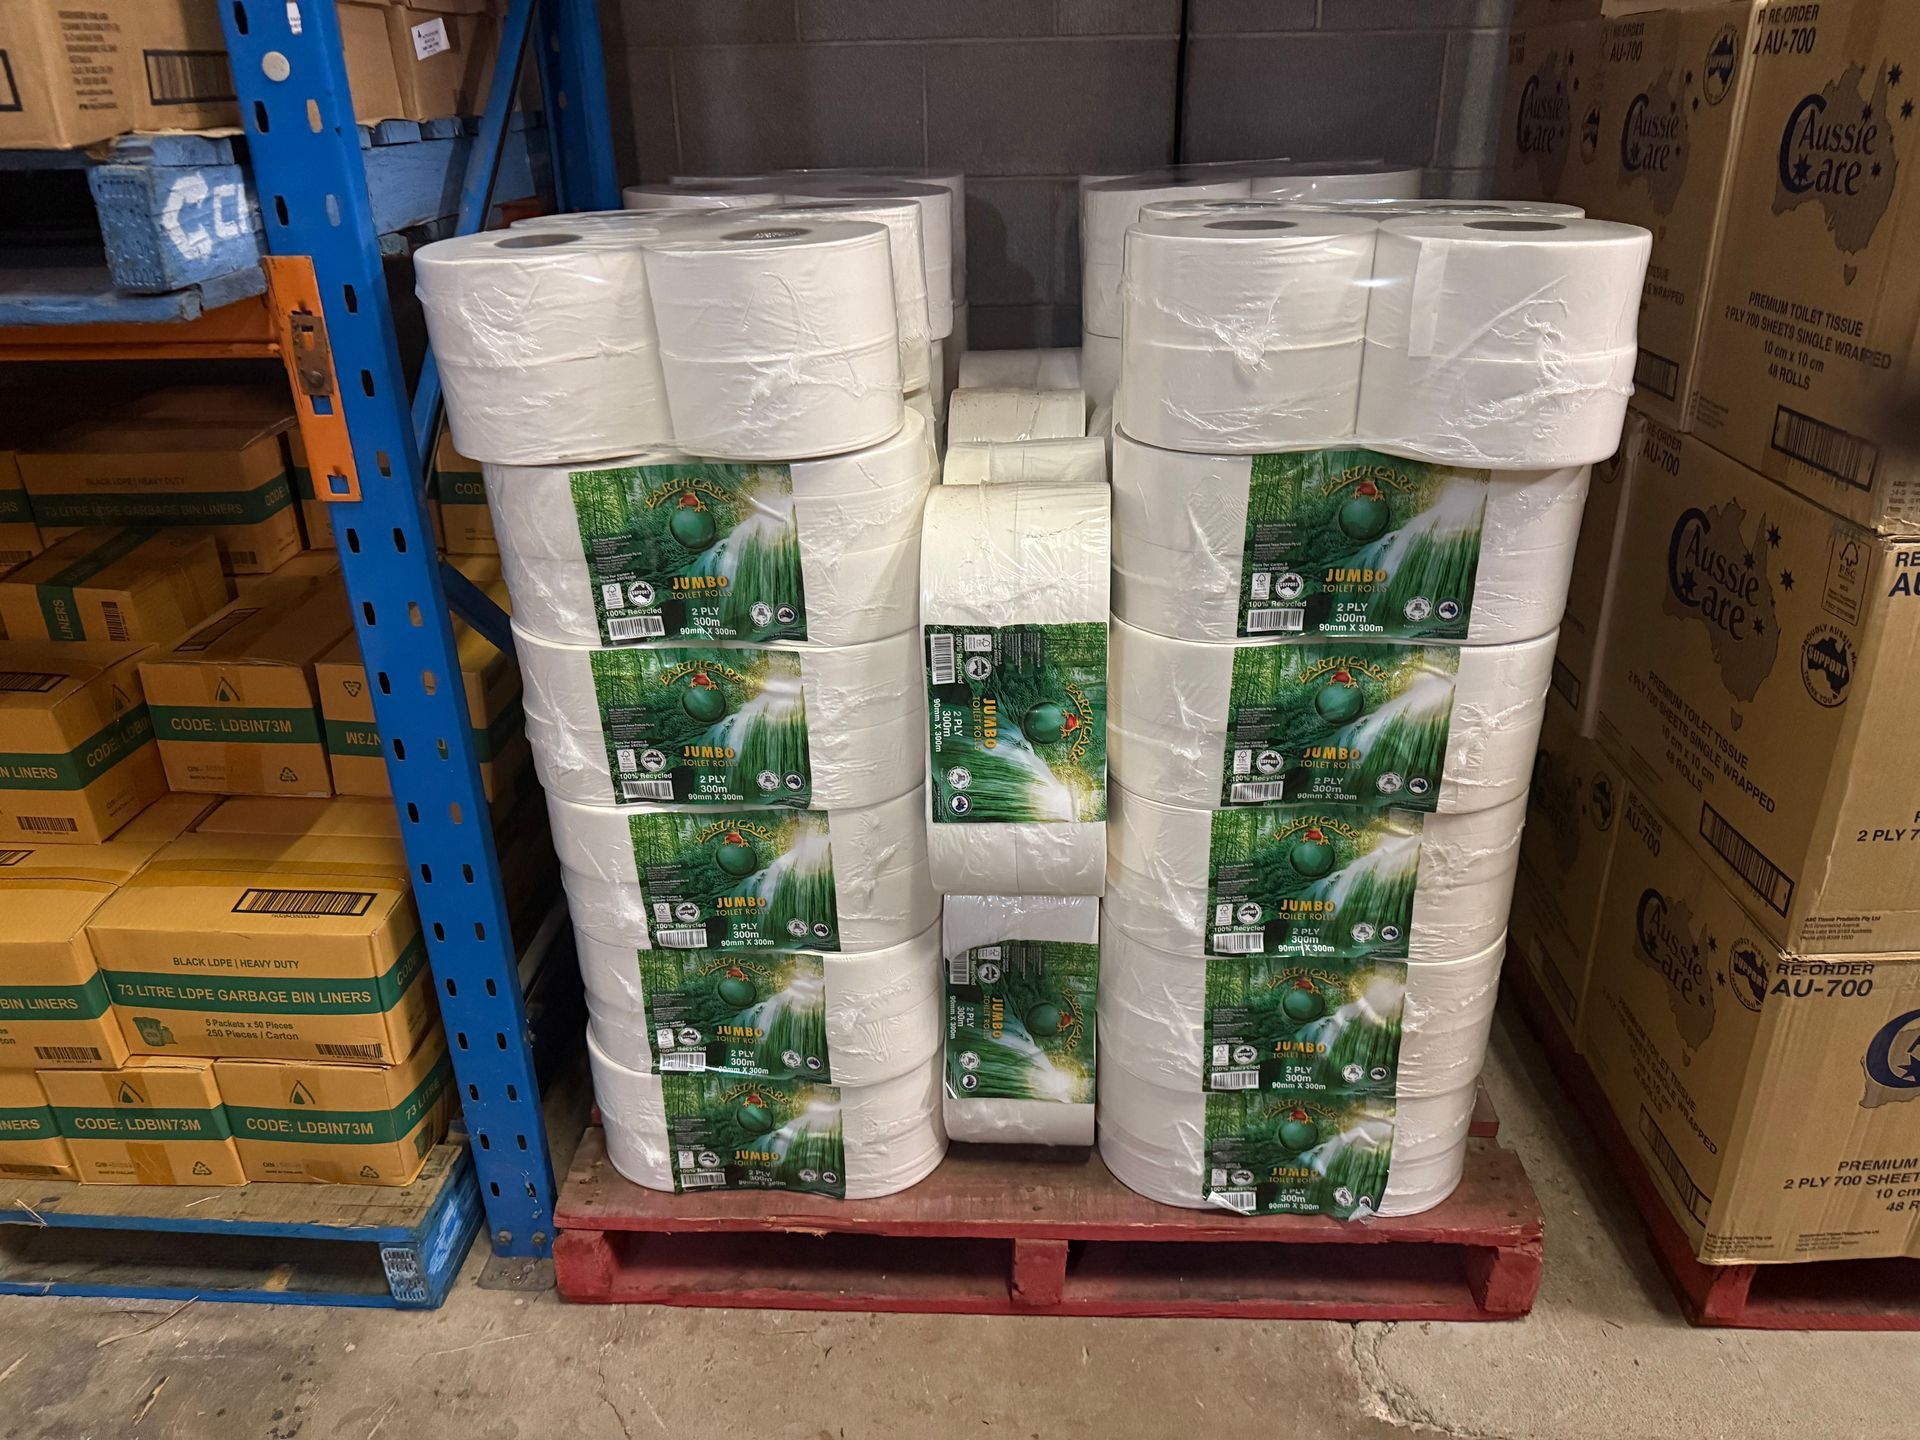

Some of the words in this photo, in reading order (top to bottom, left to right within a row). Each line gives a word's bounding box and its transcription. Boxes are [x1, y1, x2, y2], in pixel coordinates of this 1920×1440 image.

[1768, 4, 1820, 24] RE-ORDER
[1762, 27, 1816, 54] AU-700
[1610, 40, 1642, 63] AU-700
[1633, 104, 1679, 138] Aussie
[1621, 93, 1670, 172] Care
[1798, 109, 1877, 155] Aussie
[1779, 93, 1862, 196] Care
[1748, 292, 1789, 315] PREMIUM
[1790, 303, 1824, 326] TOILET
[1826, 313, 1863, 337] TISSUE
[1729, 306, 1746, 322] PLY
[1746, 312, 1760, 329] 700
[1761, 316, 1795, 339] SHEETS
[1797, 328, 1833, 352] SINGLE
[1763, 340, 1773, 354] 10
[1774, 345, 1787, 359] cm
[1789, 352, 1794, 361] x
[1798, 351, 1808, 366] 10
[1809, 358, 1824, 373] cm
[1779, 368, 1811, 391] ROLLS
[1644, 439, 1680, 477] AU-700
[1321, 465, 1417, 497] EARTHCARE
[1668, 507, 1745, 641] Care
[1685, 524, 1760, 607] Aussie
[672, 576, 729, 590] JUMBO
[1326, 569, 1388, 582] JUMBO
[1322, 584, 1354, 593] TOILET
[1358, 584, 1387, 592] ROLLS
[701, 607, 719, 616] PLY
[1347, 603, 1368, 612] PLY
[52, 600, 74, 641] LINERS
[694, 617, 720, 626] 300m
[1335, 613, 1366, 623] 300m
[1359, 624, 1383, 632] 300m
[1801, 624, 1828, 650] PROUDLY
[1299, 656, 1390, 684] EARTHCARE
[1807, 645, 1847, 679] SUPPORT
[659, 660, 744, 686] EARTHCARE
[1819, 693, 1833, 704] YOU
[171, 718, 217, 731] CODE:
[221, 719, 292, 733] LDBIN73M
[943, 711, 951, 737] 300m
[983, 698, 998, 748] JUMBO
[1648, 671, 1683, 711] PREMIUM
[1684, 704, 1713, 738] TOILET
[1714, 731, 1749, 770] TISSUE
[1628, 670, 1633, 682] 2
[1633, 674, 1647, 696] PLY
[1659, 702, 1688, 737] SHEETS
[1690, 730, 1721, 769] SINGLE
[1723, 762, 1775, 813] WRAPPED
[683, 746, 735, 759] JUMBO
[1303, 747, 1361, 760] JUMBO
[1662, 724, 1670, 739] 10
[1670, 735, 1683, 753] cm
[1691, 753, 1700, 770] 10
[1702, 767, 1715, 784] cm
[709, 775, 726, 783] PLY
[1676, 758, 1703, 793] ROLLS
[701, 785, 727, 793] 300m
[1313, 785, 1342, 793] 300m
[695, 819, 776, 844] EARTHCARE
[1273, 816, 1360, 841] EARTHCARE
[1624, 807, 1661, 858] AU-700
[1857, 830, 1868, 842] 2
[1872, 829, 1906, 841] PLY
[717, 897, 767, 908] JUMBO
[1281, 899, 1335, 912] JUMBO
[1292, 936, 1319, 944] 300m
[1636, 888, 1692, 1005] Care
[1651, 904, 1703, 986] Aussie
[173, 957, 206, 967] BLACK
[208, 957, 233, 967] LDPE
[240, 958, 271, 968] HEAVY
[274, 959, 299, 969] DUTY
[1776, 964, 1875, 976] RE-ORDER
[117, 984, 134, 996] 73
[136, 986, 175, 998] LITRE
[178, 988, 214, 1001] LDPE
[217, 989, 288, 1003] GARBAGE
[292, 991, 315, 1004] BIN
[319, 991, 372, 1004] LINERS
[1770, 979, 1873, 998] AU-700
[27, 998, 78, 1010] LINERS
[205, 1018, 211, 1026] 5
[212, 1019, 245, 1029] Packets
[254, 1021, 263, 1029] 50
[265, 1021, 293, 1030] Pieces
[957, 1007, 965, 1027] 300m
[992, 998, 1004, 1039] JUMBO
[206, 1029, 224, 1038] 250
[226, 1029, 259, 1039] Pieces
[266, 1031, 299, 1041] Carton
[717, 1026, 764, 1037] JUMBO
[1274, 1041, 1327, 1054] JUMBO
[731, 1058, 755, 1067] 300m
[1285, 1074, 1311, 1082] 300m
[406, 1104, 417, 1120] 73
[75, 1118, 123, 1130] CODE:
[125, 1119, 201, 1131] LDBIN73M
[246, 1117, 294, 1132] CODE:
[297, 1122, 374, 1135] LDBIN73M
[1677, 1100, 1718, 1155] WRAPPED
[735, 1151, 781, 1161] JUMBO
[1837, 1157, 1920, 1171] PREMIUM
[1272, 1168, 1318, 1177] JUMBO
[1783, 1179, 1795, 1189] 2
[1798, 1176, 1830, 1188] PLY
[1833, 1175, 1862, 1186] 700
[1281, 1195, 1305, 1203] 300m
[1875, 1188, 1893, 1199] 10
[1886, 1201, 1904, 1212] 48
